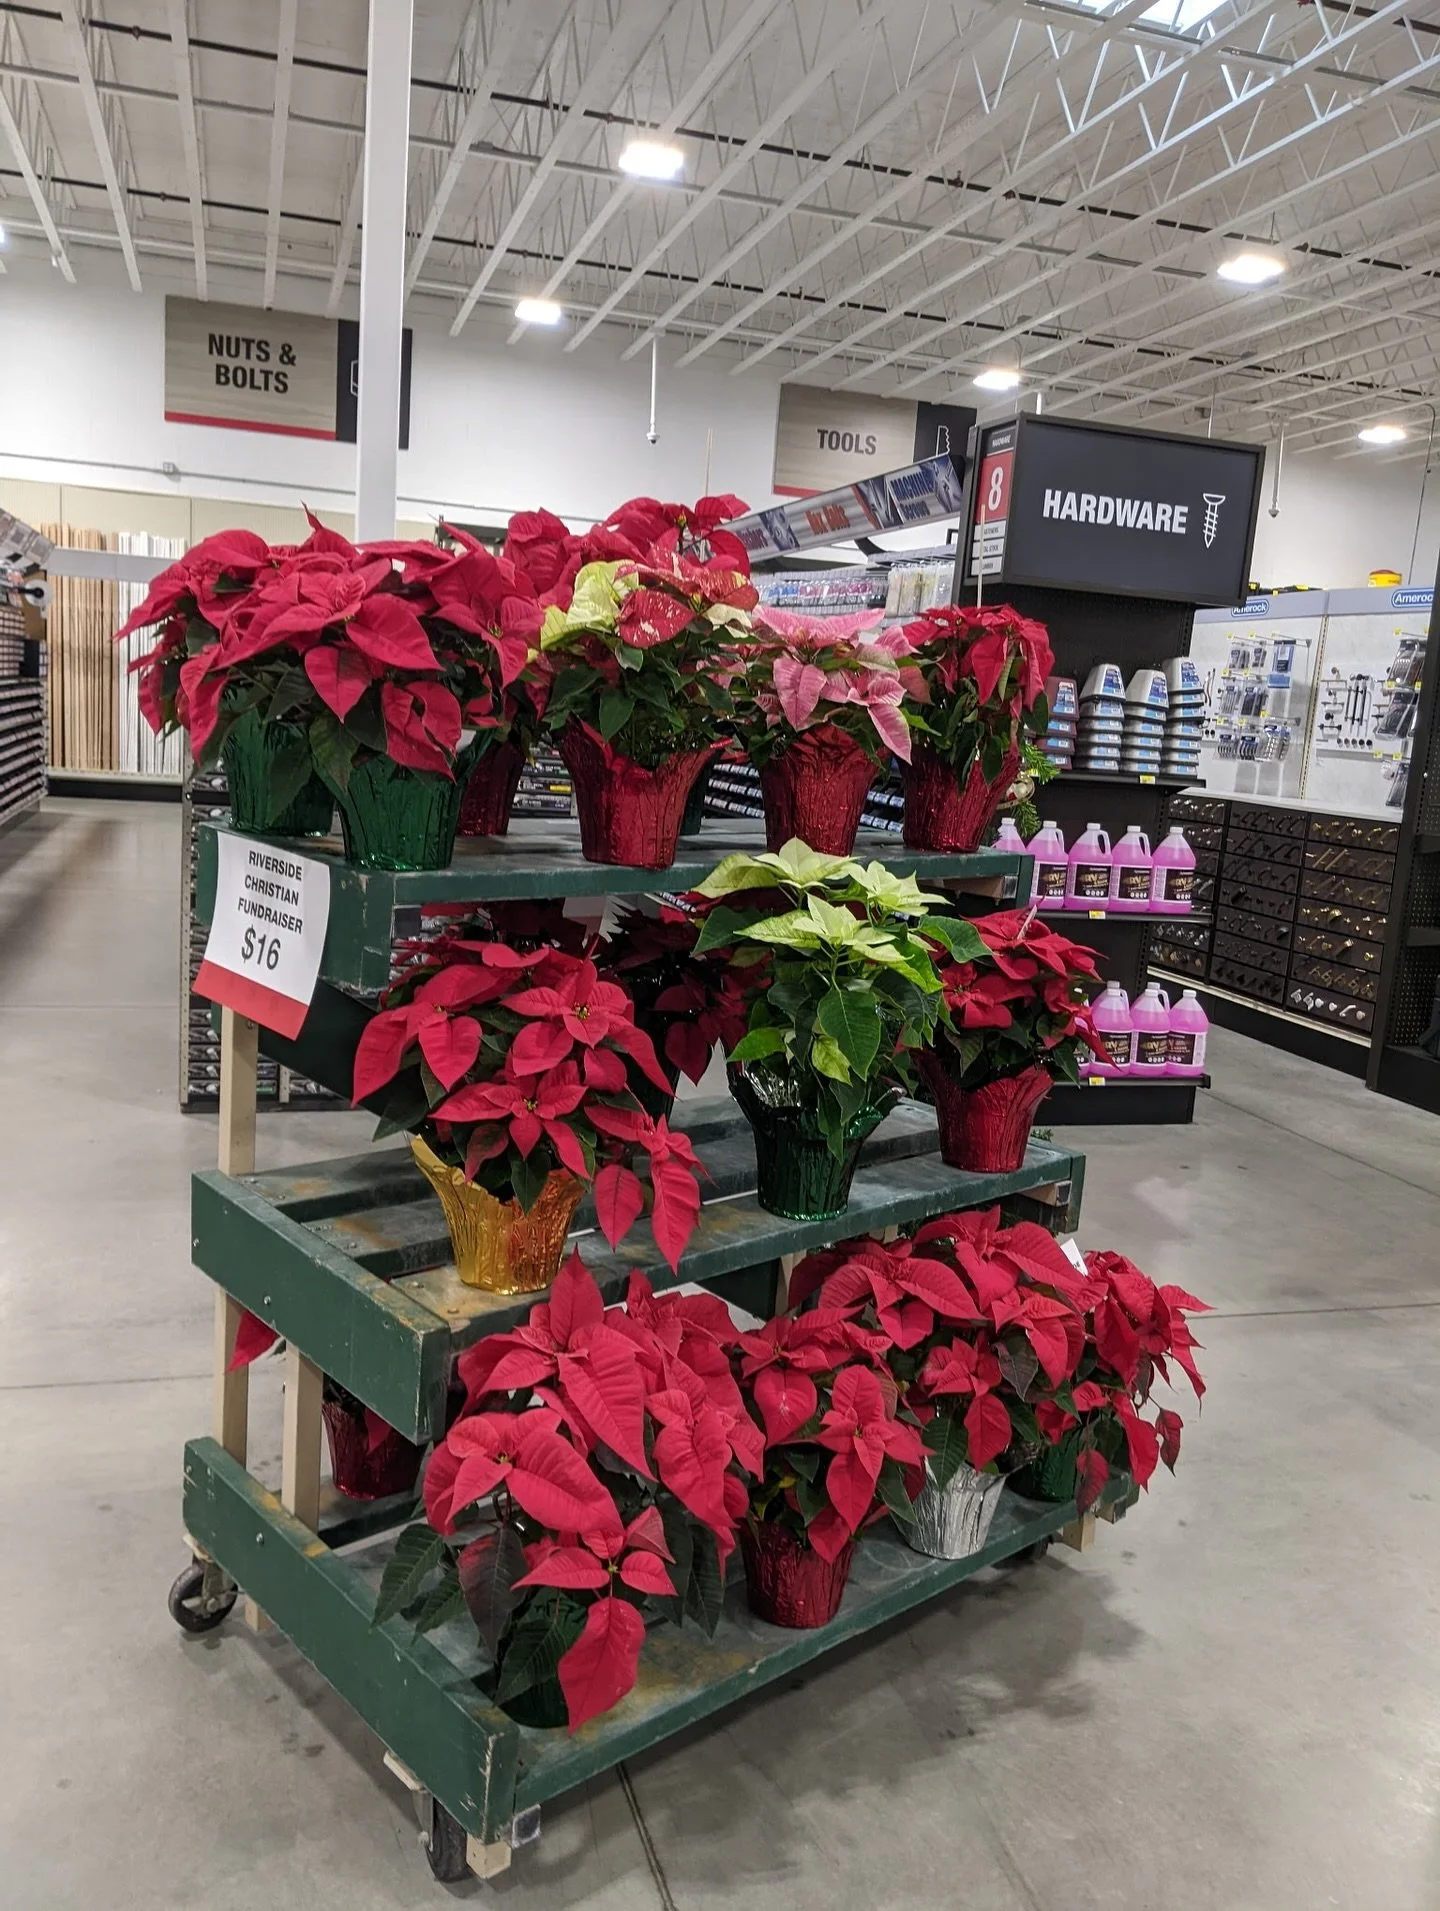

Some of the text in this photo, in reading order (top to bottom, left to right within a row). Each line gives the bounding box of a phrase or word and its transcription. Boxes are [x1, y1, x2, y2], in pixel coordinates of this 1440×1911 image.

[208, 333, 296, 366] NUTS &
[215, 364, 289, 394] BOLTS
[817, 428, 877, 455] TOOLS
[988, 466, 1004, 511] 8
[1042, 488, 1189, 535] HARDWARE
[1395, 593, 1434, 604] Ameroc
[249, 850, 302, 880] RIVERSIDE
[244, 874, 299, 906] CHRISTIAN
[238, 897, 303, 934] FUNDRAISER
[241, 924, 281, 970] $16
